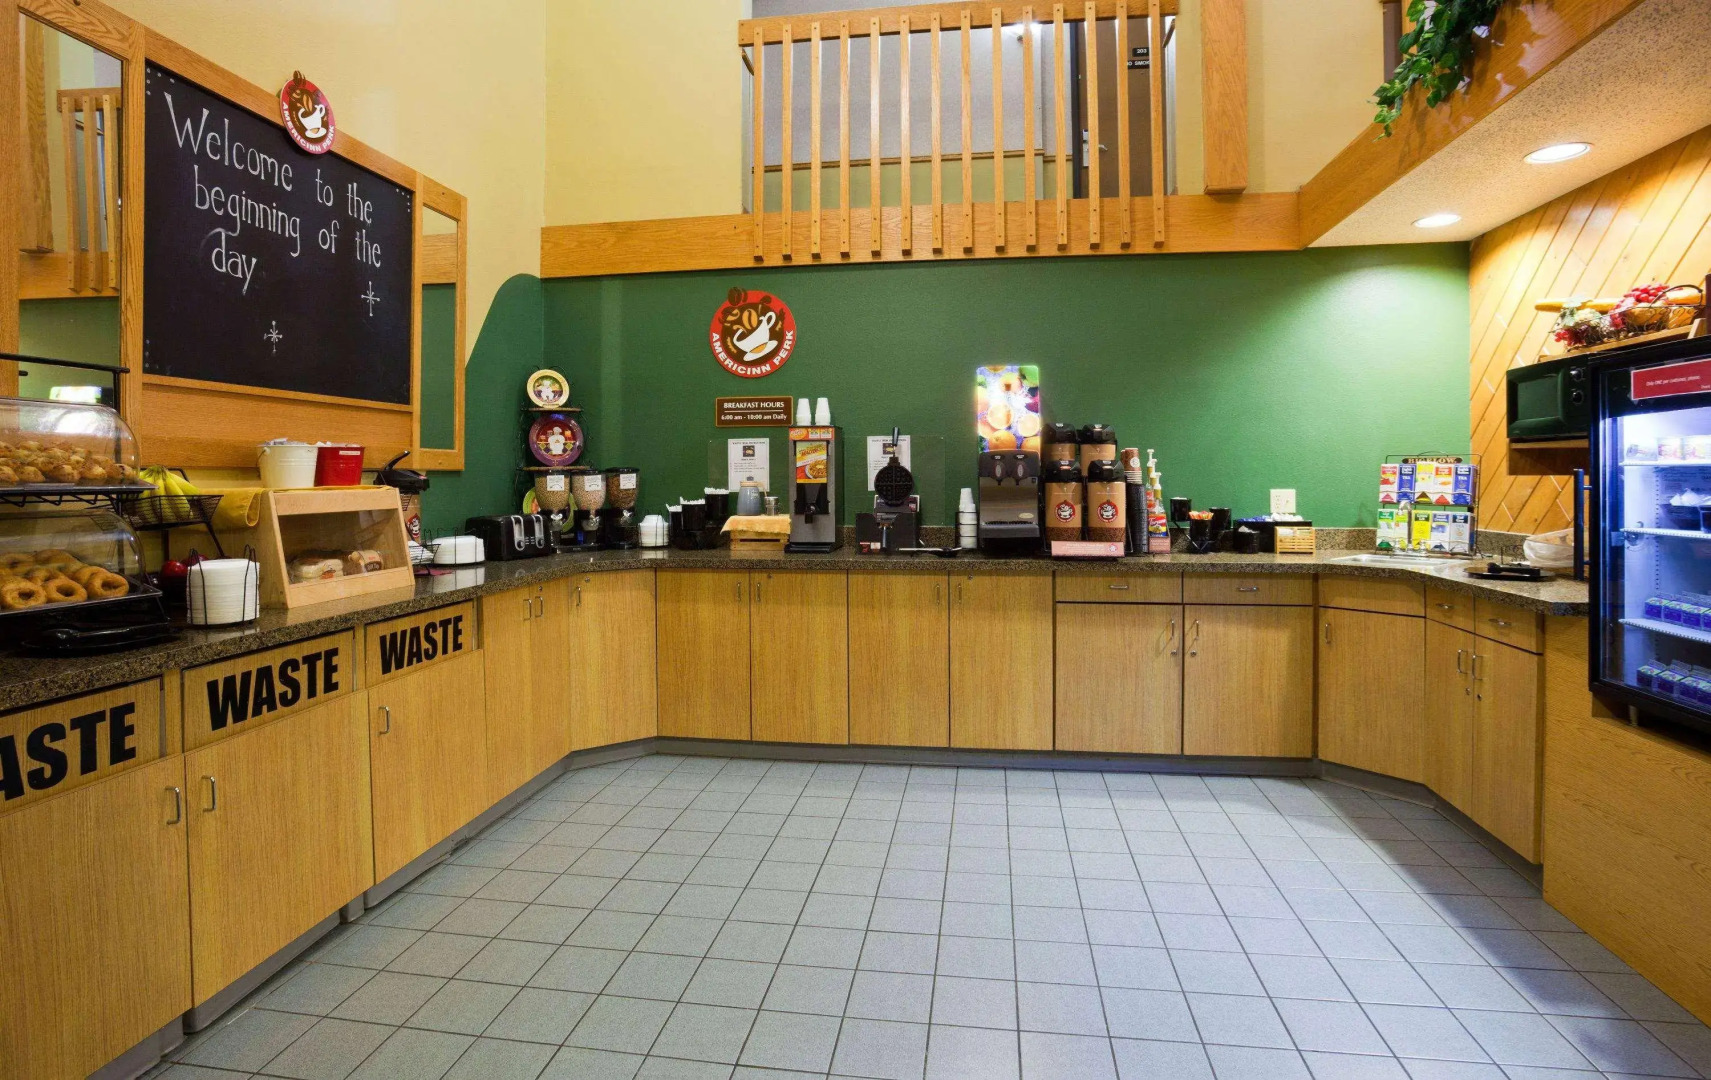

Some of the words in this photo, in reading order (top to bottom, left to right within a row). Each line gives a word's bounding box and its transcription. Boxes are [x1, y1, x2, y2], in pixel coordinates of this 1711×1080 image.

[164, 92, 292, 192] Welcome
[315, 168, 334, 207] to
[347, 183, 373, 225] the
[282, 101, 322, 152] AMERICINN
[322, 125, 335, 149] PERK
[194, 165, 301, 257] beginning
[318, 220, 339, 254] of
[355, 230, 381, 268] the
[211, 229, 257, 295] day
[711, 332, 772, 375] AMERICINN
[773, 330, 794, 366] PERK
[379, 614, 464, 675] WASTE
[206, 646, 339, 732] WASTE
[0, 702, 137, 801] ASTE
